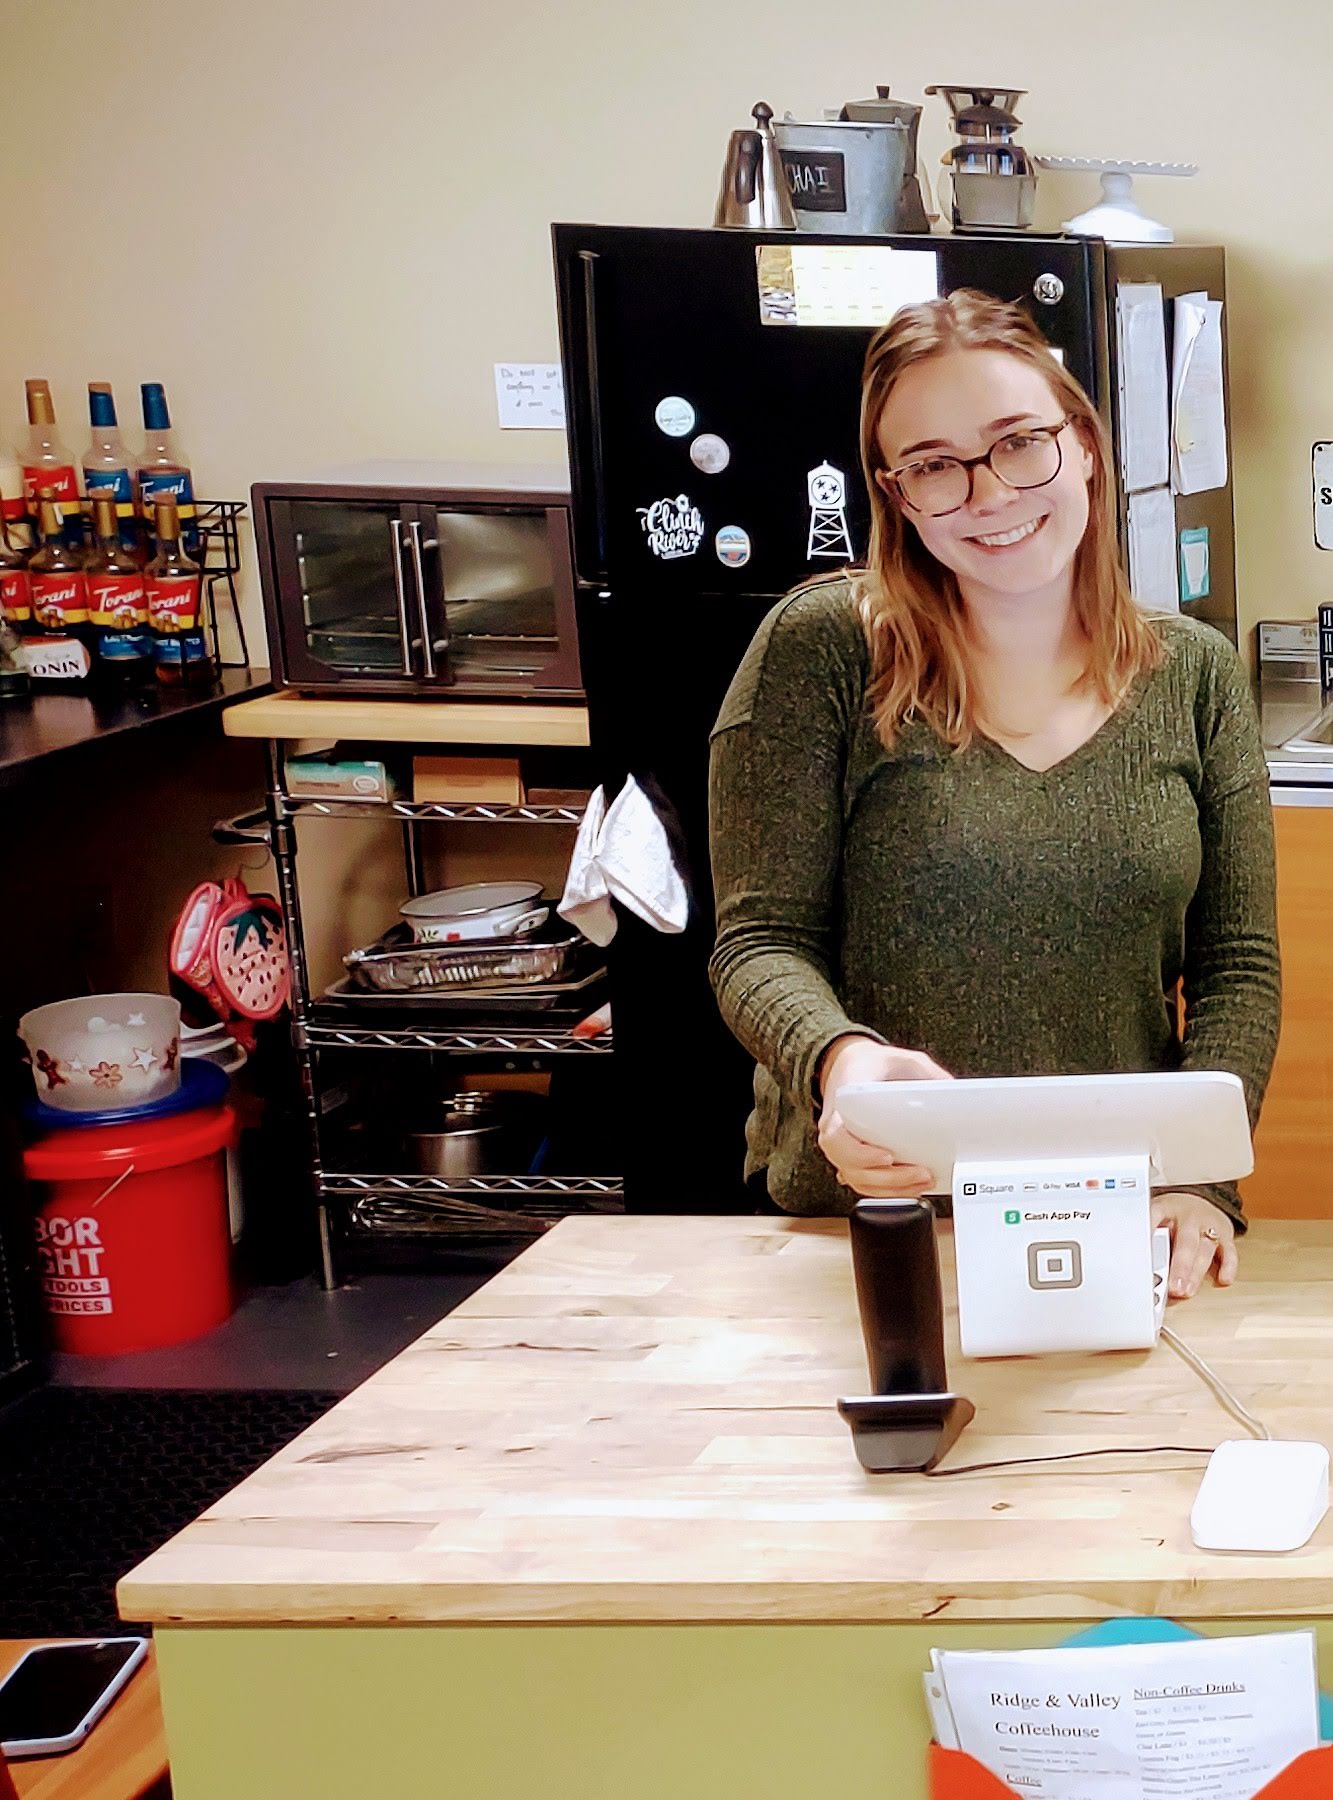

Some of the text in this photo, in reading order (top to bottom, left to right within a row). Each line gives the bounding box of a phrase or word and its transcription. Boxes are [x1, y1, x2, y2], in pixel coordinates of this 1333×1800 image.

[647, 501, 705, 536] Clinch
[32, 659, 81, 677] ONIN
[1024, 1210, 1092, 1222] Cash App Pay
[1133, 1681, 1246, 1701] Non-Coffee Drinks
[991, 1692, 1122, 1711] Ridge & Valley
[994, 1720, 1101, 1739] Coffeehouse
